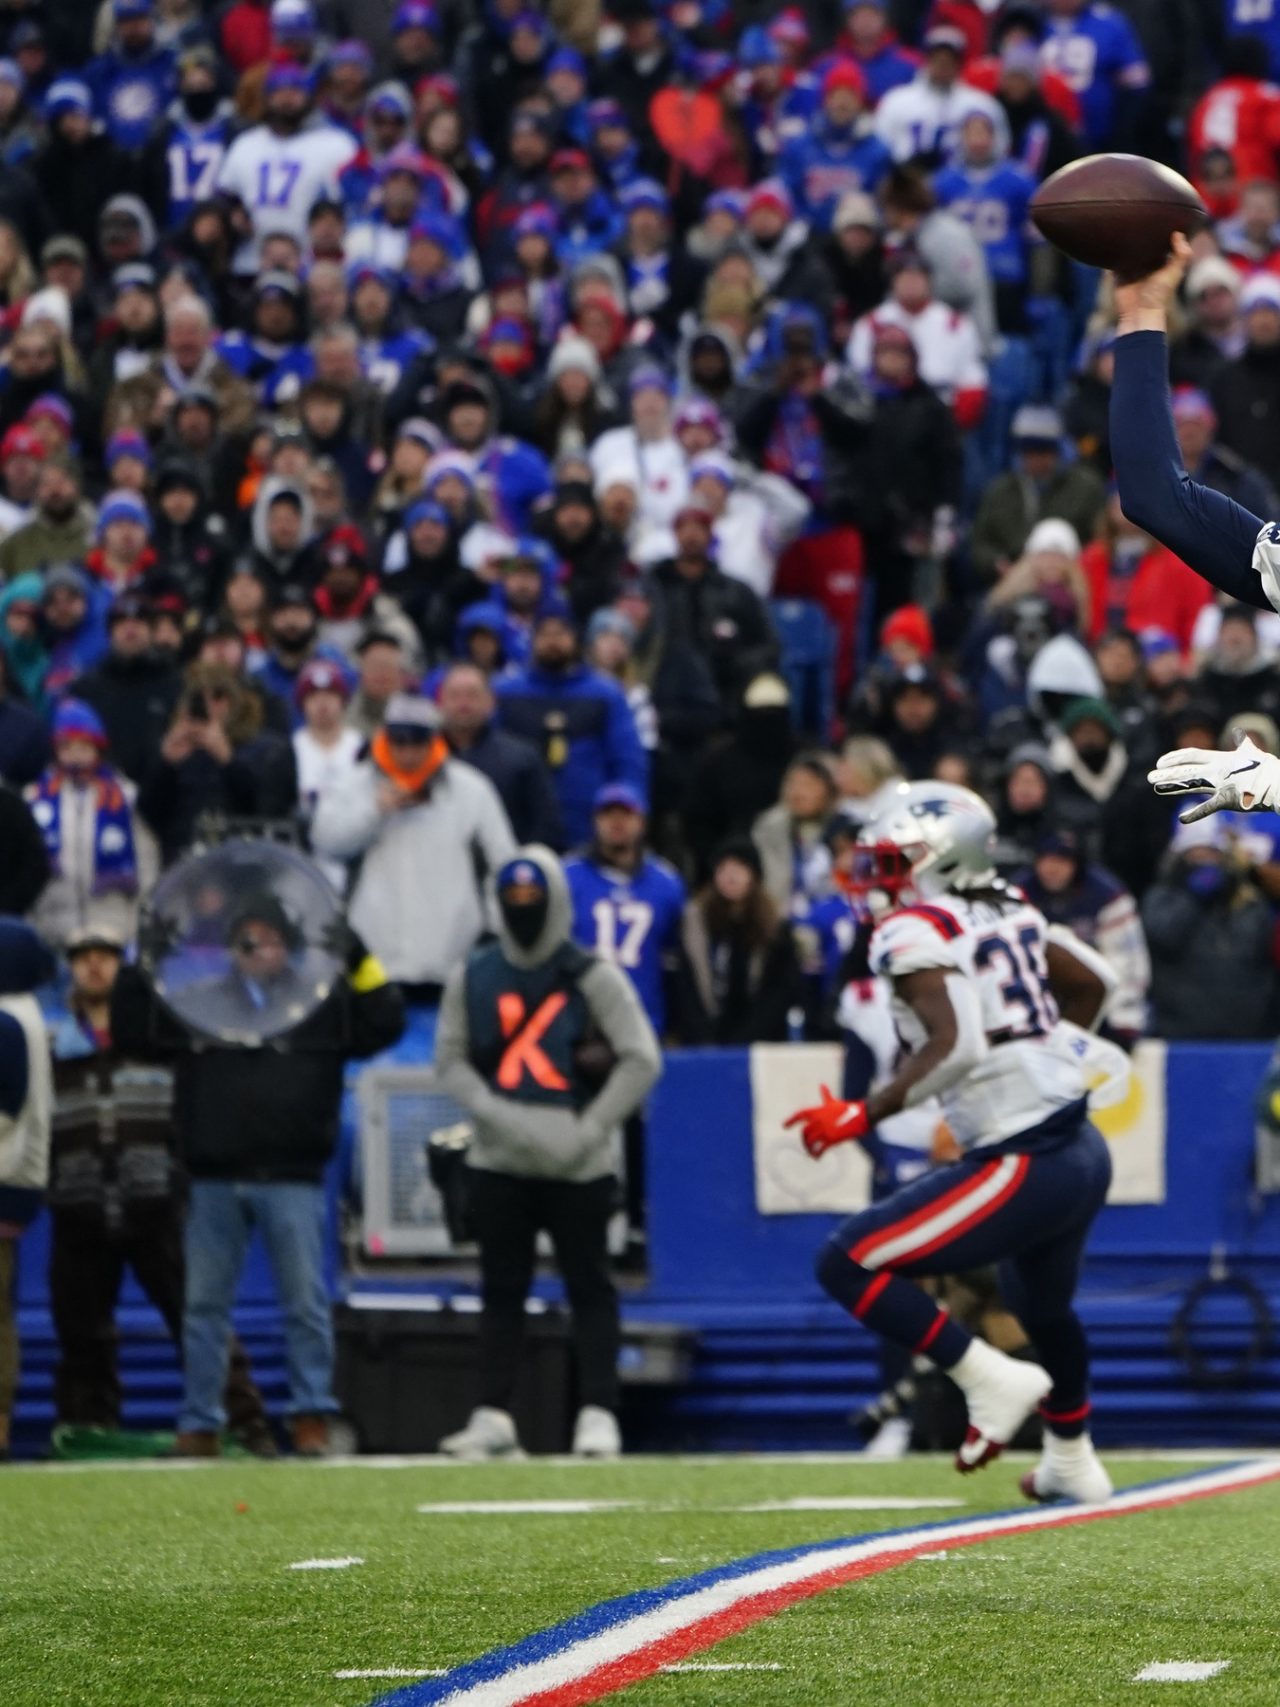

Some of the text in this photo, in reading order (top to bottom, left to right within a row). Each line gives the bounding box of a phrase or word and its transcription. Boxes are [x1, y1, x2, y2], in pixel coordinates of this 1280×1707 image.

[168, 146, 222, 200] 17
[257, 161, 301, 209] 17
[592, 902, 653, 969] 17
[498, 991, 569, 1092] K
